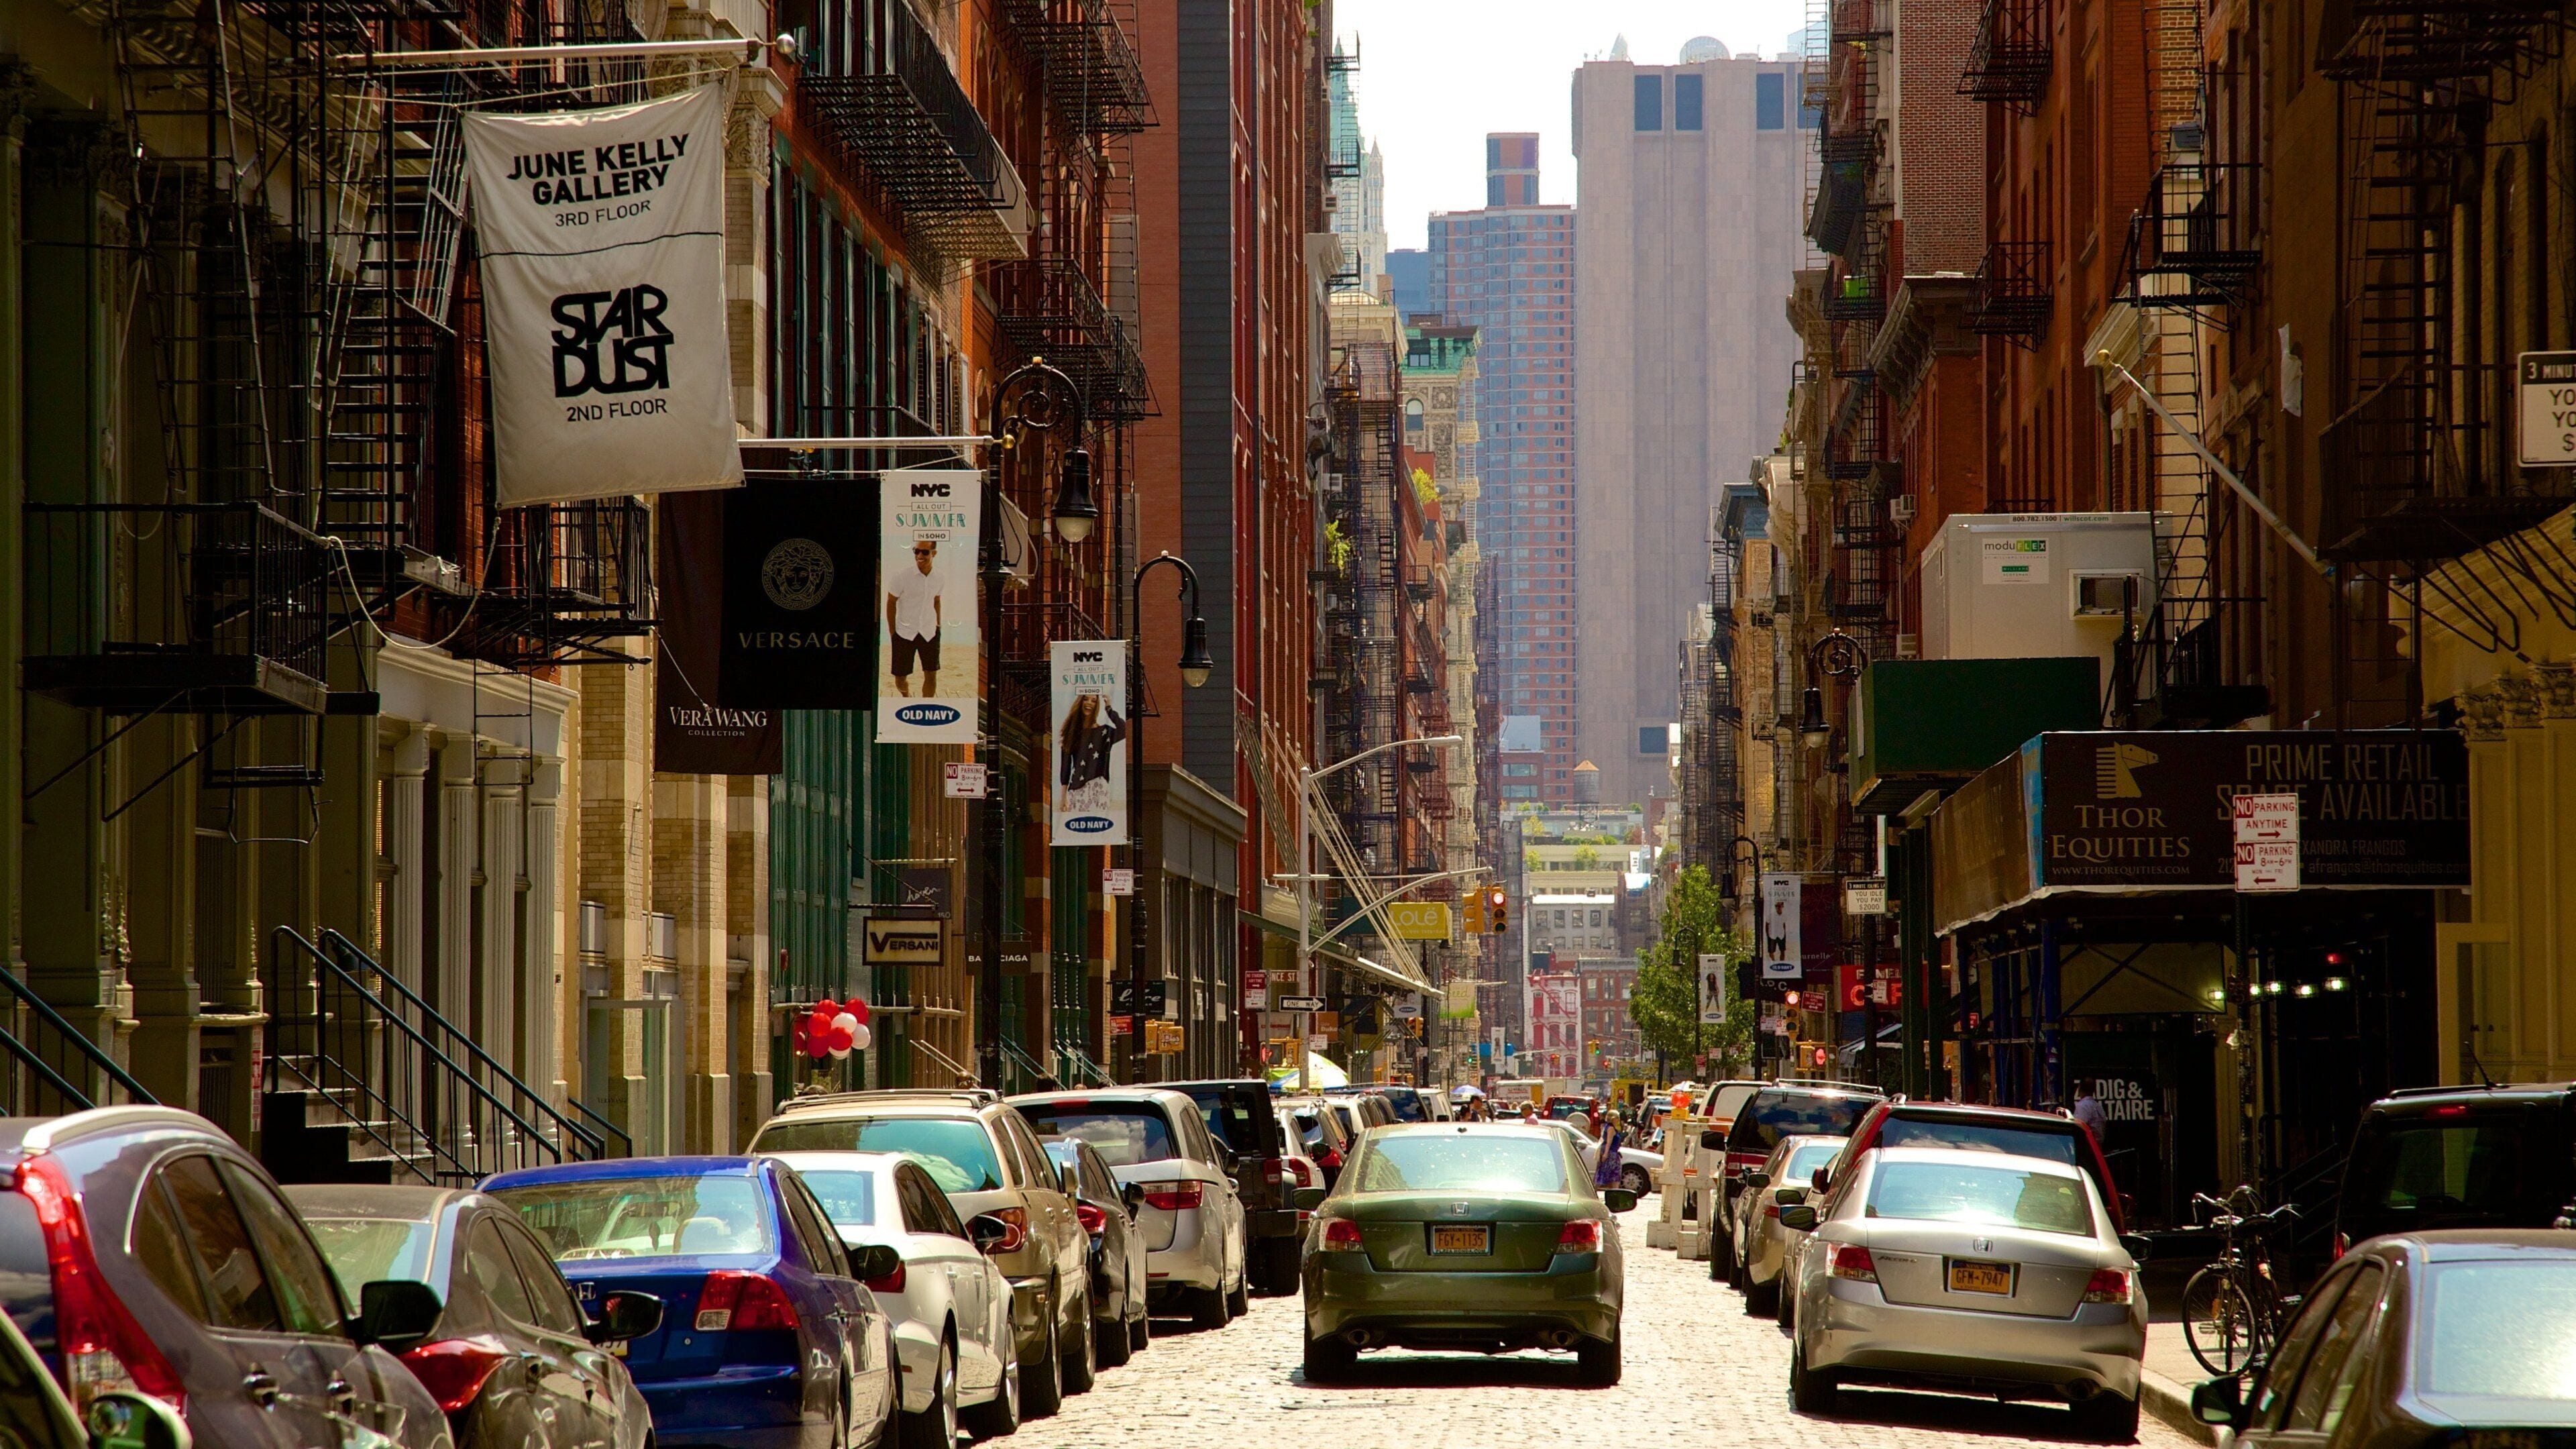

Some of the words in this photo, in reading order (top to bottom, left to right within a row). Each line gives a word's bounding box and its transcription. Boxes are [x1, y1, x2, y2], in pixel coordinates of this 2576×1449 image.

[506, 150, 586, 180] JUNE
[596, 133, 690, 173] KELLY
[533, 164, 669, 206] GALLERY
[555, 211, 590, 227] 3RD
[596, 200, 651, 223] FLOOR
[551, 284, 674, 347] STAR
[552, 333, 674, 398] DUST
[2528, 362, 2537, 379] 3
[2542, 364, 2576, 379] MINU
[566, 406, 602, 423] 2ND
[609, 398, 667, 419] FLOOR
[911, 484, 951, 497] NYC
[896, 513, 966, 528] SUMMER
[739, 632, 855, 649] VERSACE
[1073, 652, 1103, 663] NYC
[1063, 673, 1115, 685] SUMMER
[669, 706, 712, 727] VERA
[714, 708, 767, 728] WANG
[902, 710, 923, 720] OLD
[925, 710, 954, 720] NAVY
[2246, 744, 2332, 780] PRIME
[2345, 743, 2440, 780] RETAIL
[947, 765, 957, 777] NO
[2237, 799, 2253, 815] NO
[2254, 802, 2295, 812] PARKING
[2320, 784, 2469, 821] AVAILABLE
[1069, 821, 1086, 829] OLD
[1087, 820, 1109, 828] NAVY
[2074, 804, 2167, 828] THOR
[2246, 819, 2288, 829] ANYTIME
[2050, 835, 2190, 863] EQUITIES
[2237, 845, 2254, 862] NO
[2259, 846, 2293, 855] PARKING
[2353, 840, 2406, 855] FRANGOS
[1105, 871, 1112, 879] NO
[2052, 865, 2190, 875] WWW.THOREQUITIES.COM
[869, 932, 938, 953] VERSANI
[1287, 972, 1296, 982] ST
[2074, 1079, 2125, 1100] ZDIG
[2127, 1081, 2143, 1099] &
